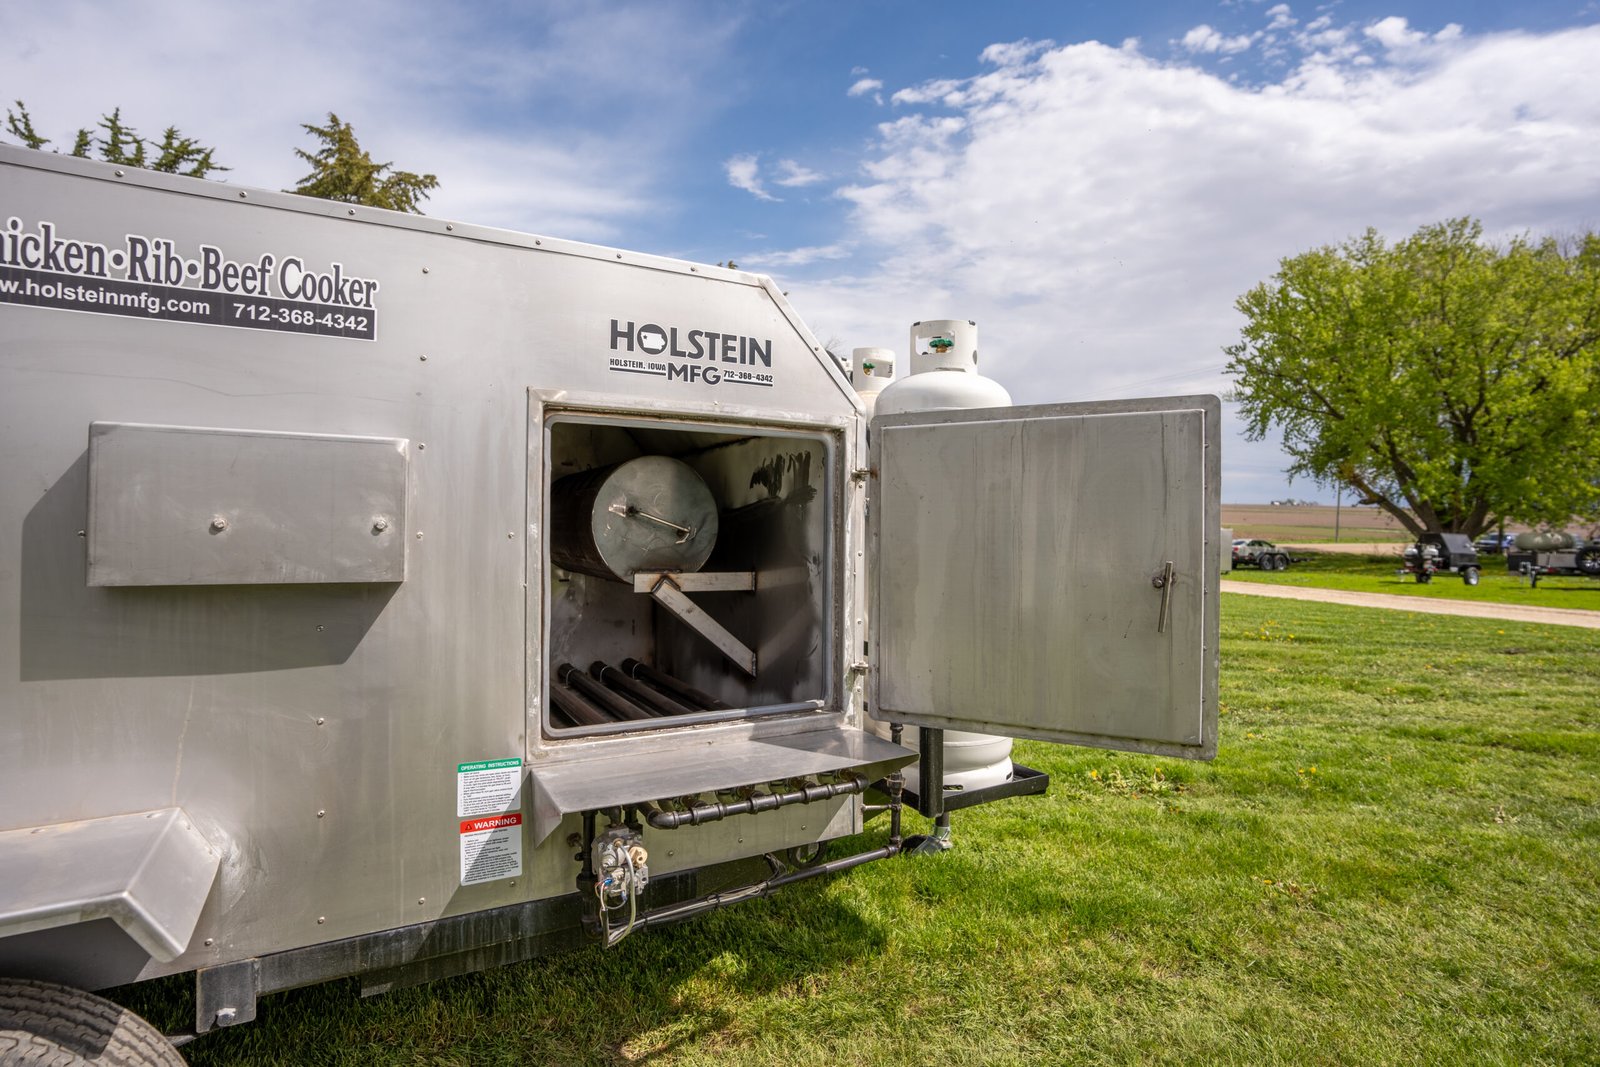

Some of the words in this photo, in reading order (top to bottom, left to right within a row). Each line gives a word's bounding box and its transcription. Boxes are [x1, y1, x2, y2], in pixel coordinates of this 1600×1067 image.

[0, 219, 107, 277] icken
[279, 258, 378, 308] Cooker
[233, 303, 369, 332] 712-368-4342
[610, 319, 772, 367] HOLSTEIN
[648, 362, 666, 371] IOWA
[667, 363, 721, 385] MFG
[723, 370, 773, 382] 712-368-4342
[460, 763, 486, 771] OPERATING
[487, 760, 520, 768] INSTRUCTIONS
[474, 817, 517, 829] WARNING
